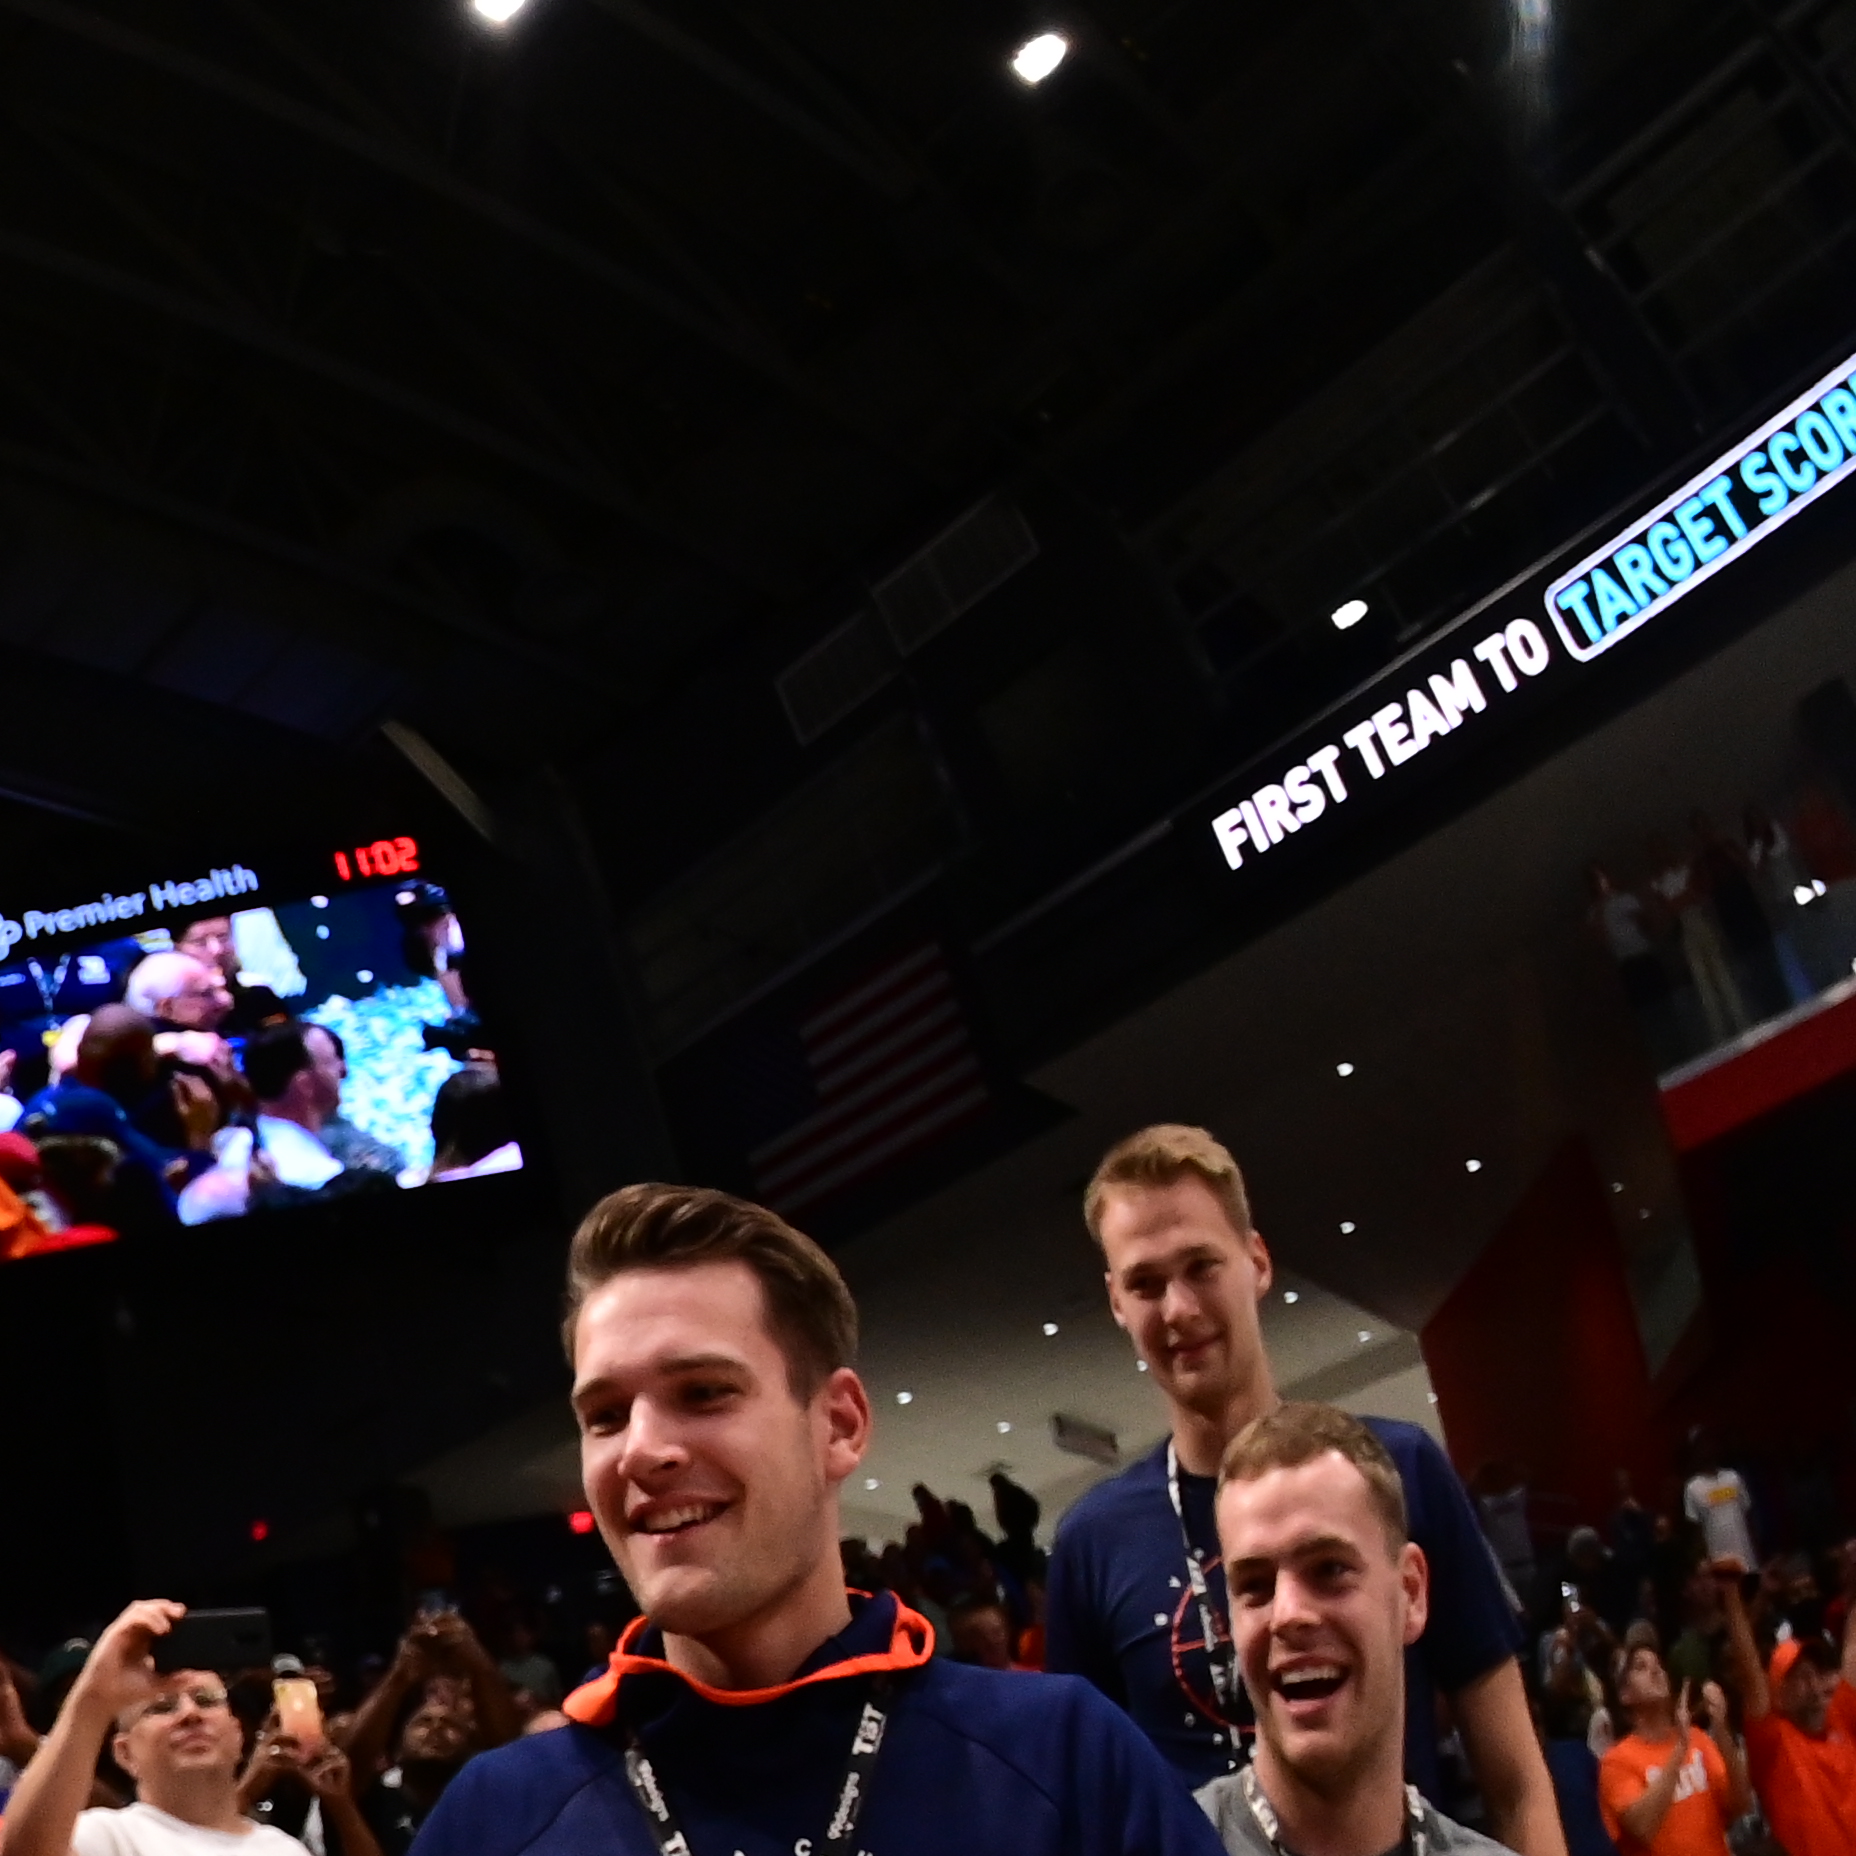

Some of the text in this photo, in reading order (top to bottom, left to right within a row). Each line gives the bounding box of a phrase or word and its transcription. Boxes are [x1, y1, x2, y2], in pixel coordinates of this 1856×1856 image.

[1211, 368, 1856, 871] FIRST TEAM TO TARGET SCOR
[23, 863, 259, 940] Premier Health
